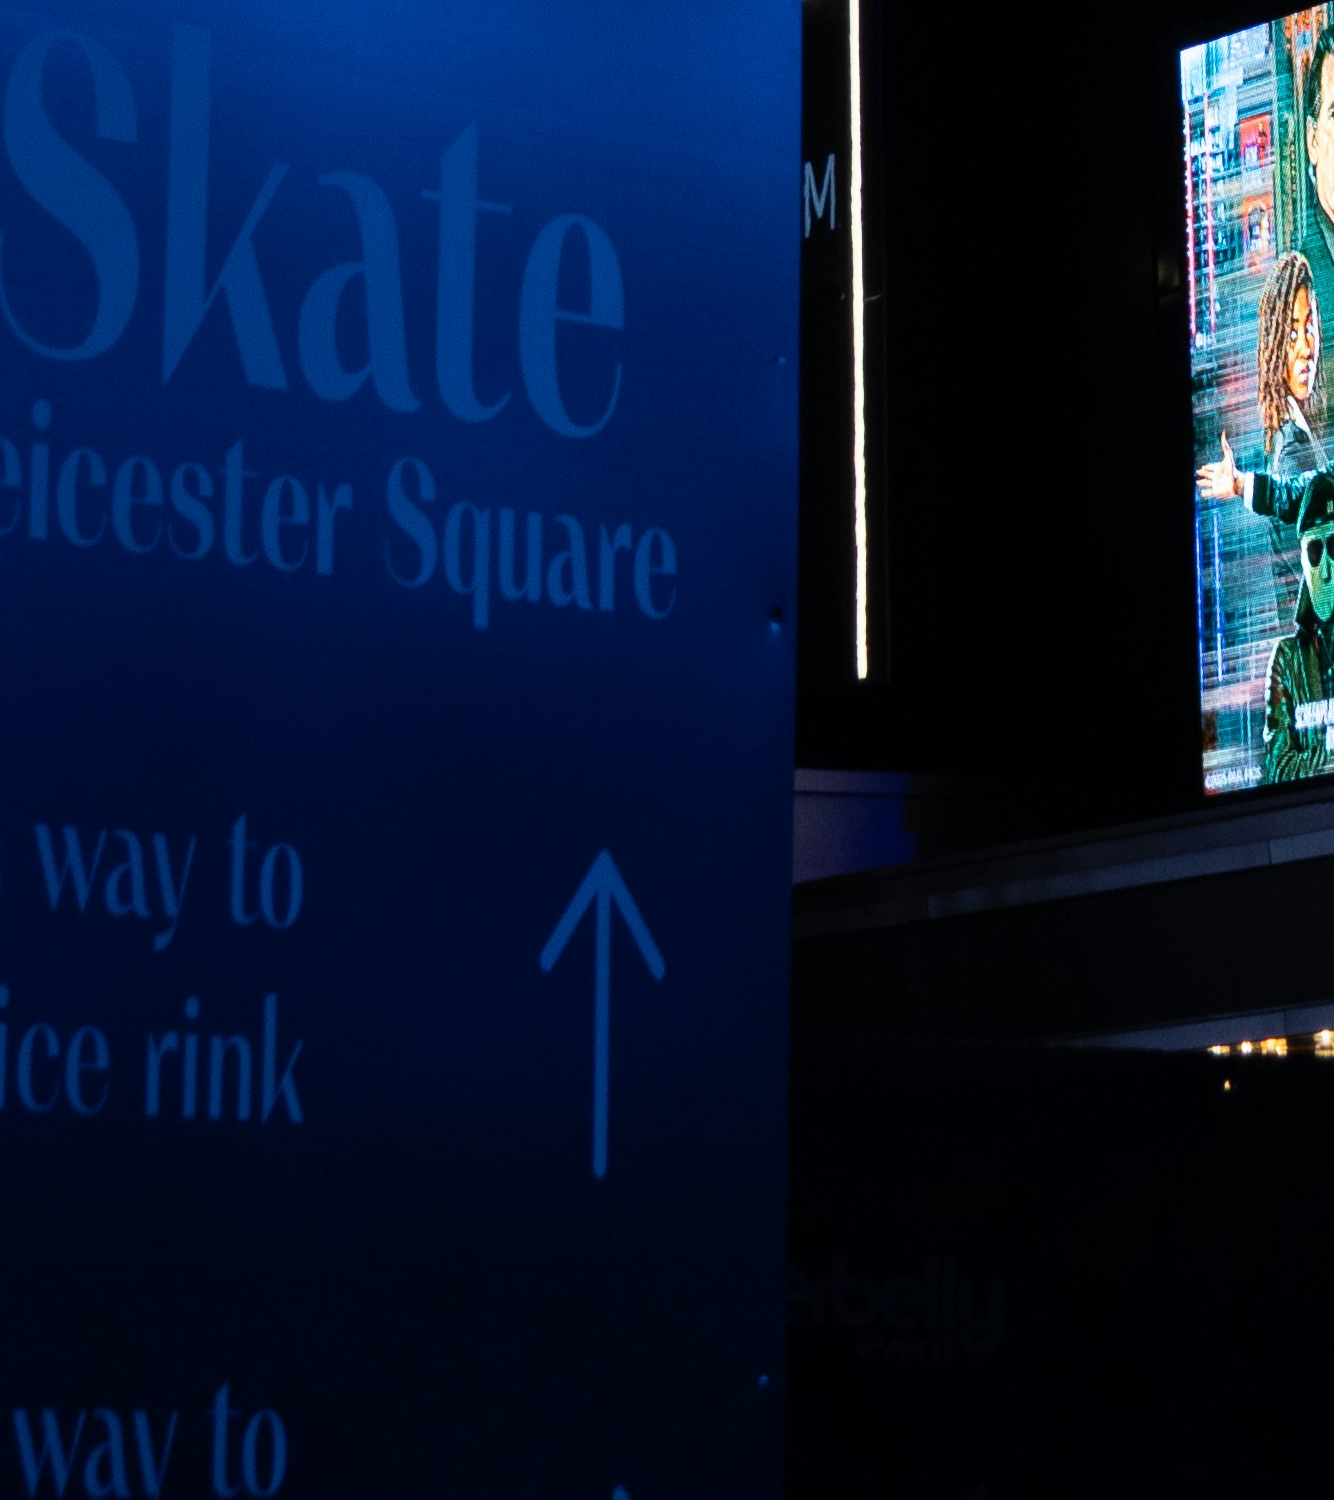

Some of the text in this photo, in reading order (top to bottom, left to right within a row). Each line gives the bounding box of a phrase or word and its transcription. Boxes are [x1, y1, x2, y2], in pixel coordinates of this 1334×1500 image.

[384, 454, 678, 631] Square
[35, 818, 195, 953] way
[227, 810, 304, 932] to
[144, 988, 304, 1128] rink
[208, 1378, 290, 1498] to
